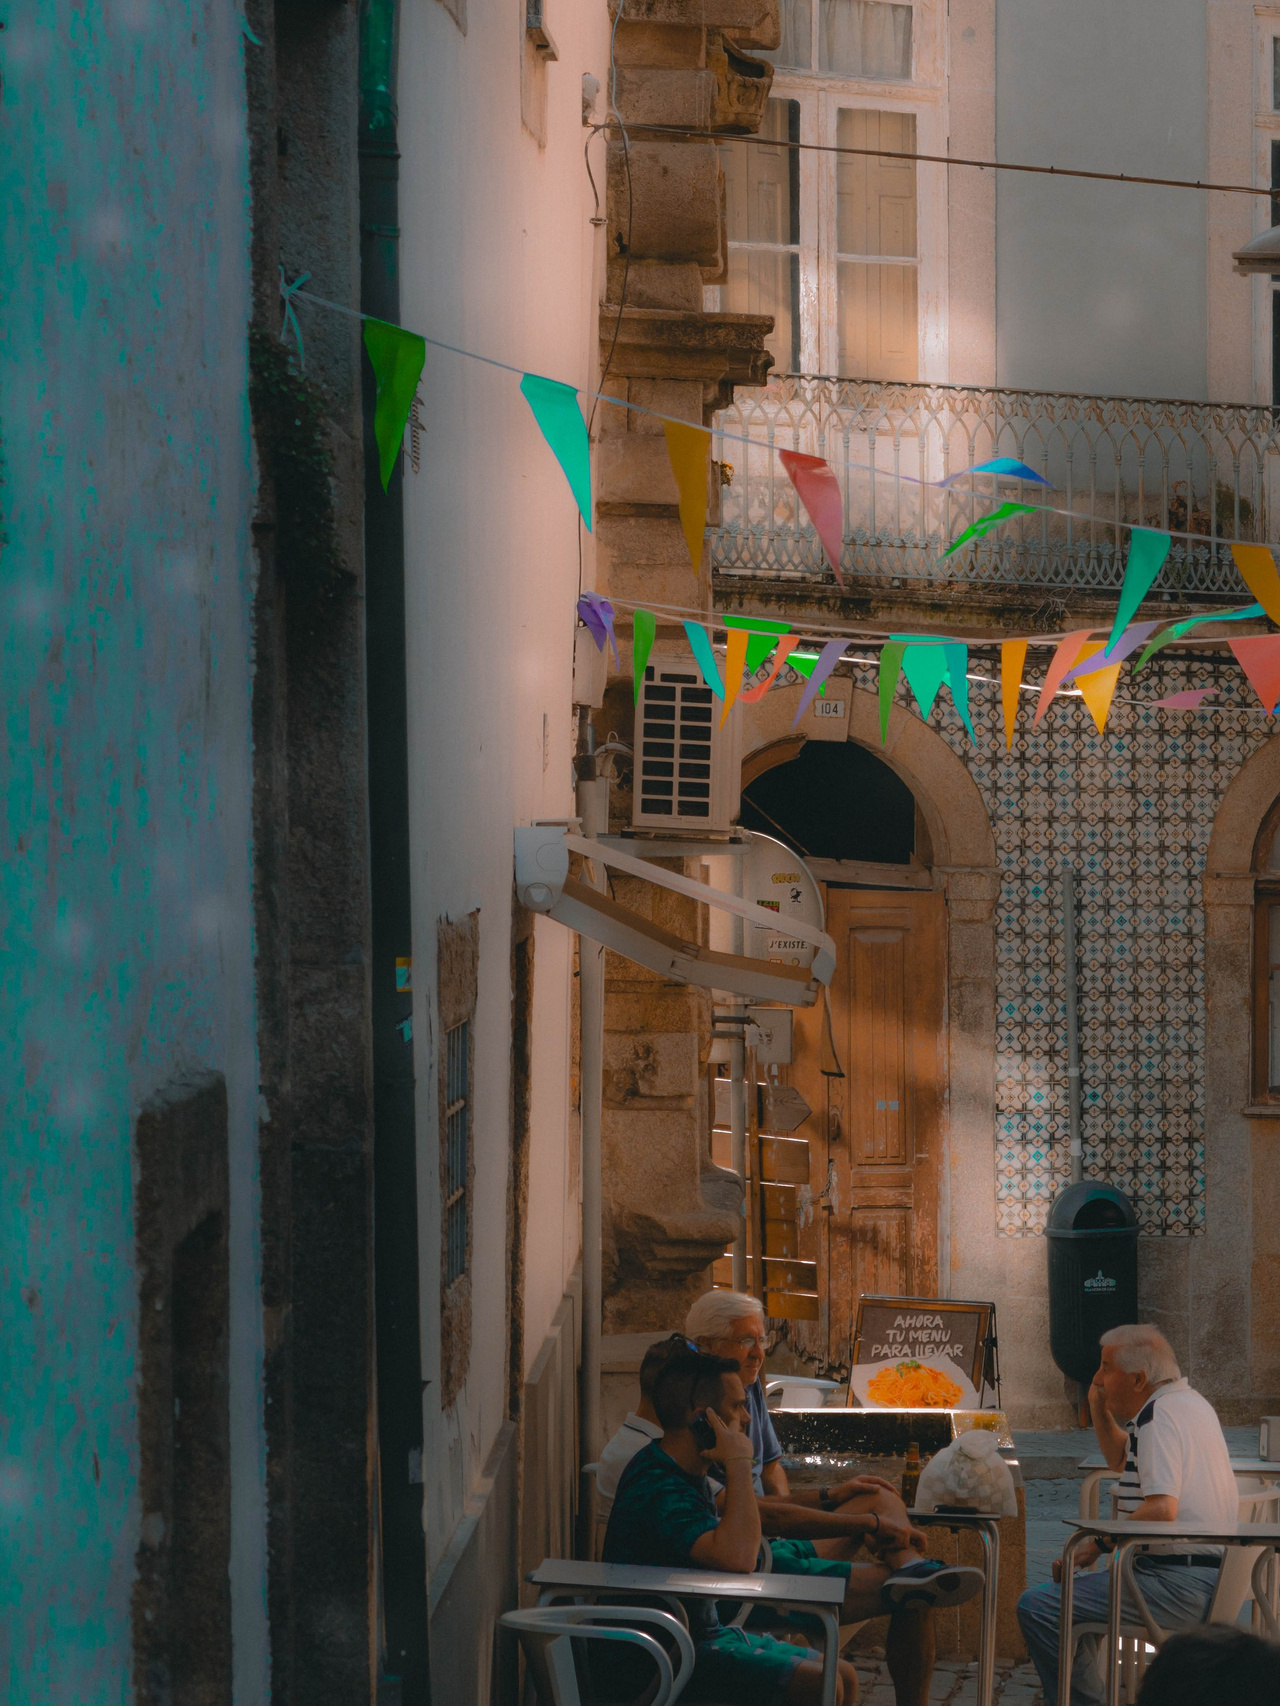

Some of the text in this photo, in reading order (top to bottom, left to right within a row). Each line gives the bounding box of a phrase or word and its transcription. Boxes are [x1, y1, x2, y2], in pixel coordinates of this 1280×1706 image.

[821, 703, 839, 715] 104
[769, 940, 808, 949] J'EXISTE.
[893, 1315, 943, 1328] AHORA
[886, 1330, 951, 1342] TU MENU
[871, 1344, 912, 1357] PARA
